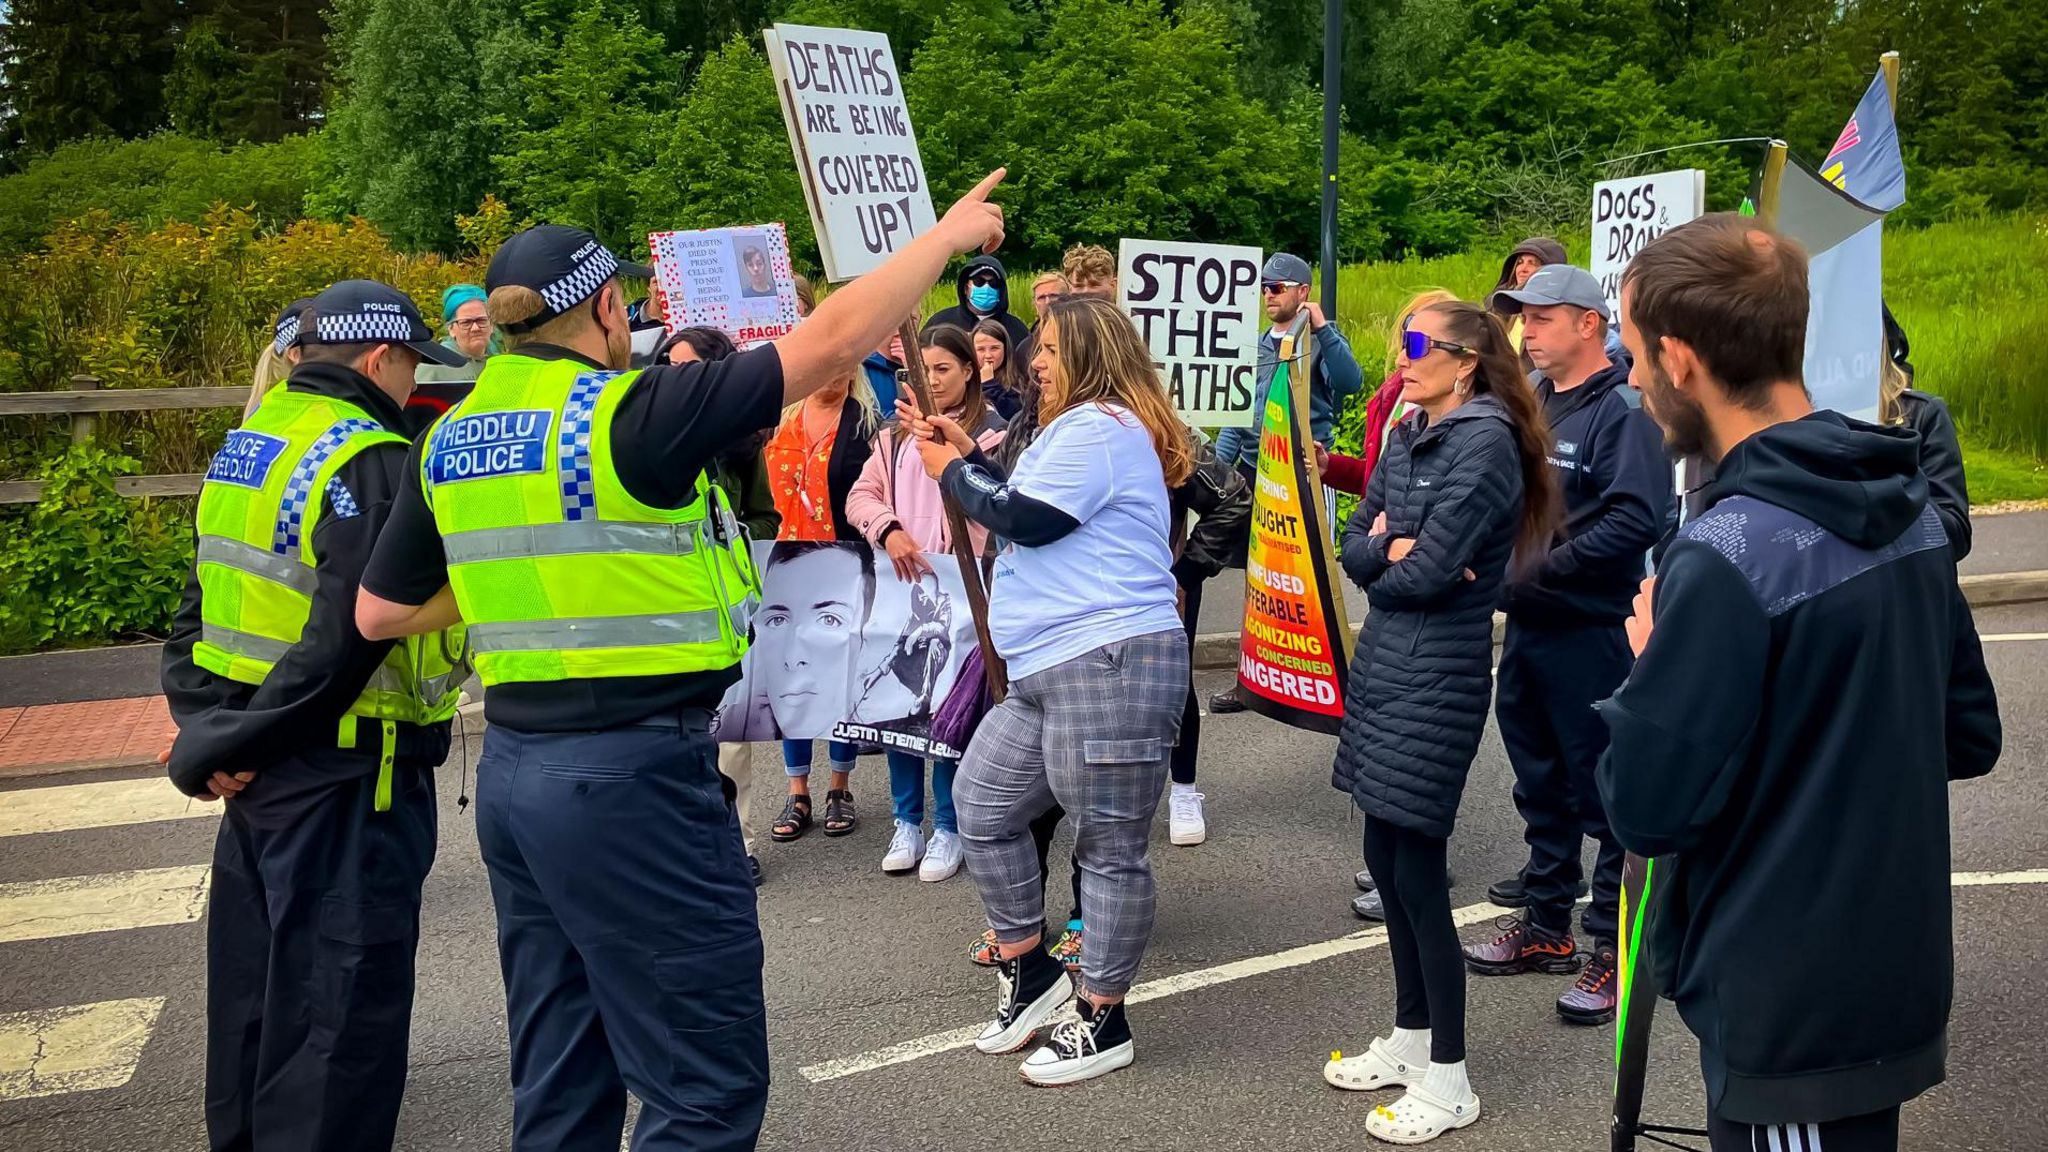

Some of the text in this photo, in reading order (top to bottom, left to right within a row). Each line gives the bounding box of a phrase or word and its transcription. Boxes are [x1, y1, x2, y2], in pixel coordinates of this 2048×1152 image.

[785, 40, 893, 96] DEATHS
[805, 104, 906, 137] ARE BEING
[818, 154, 918, 195] COVERED
[1596, 183, 1670, 226] DOGS &
[570, 240, 598, 263] POLICE
[678, 239, 723, 249] OUR JUSTIN
[688, 249, 707, 258] DIED
[687, 266, 724, 276] CELL DUE
[690, 257, 718, 267] PRISON
[694, 276, 721, 285] TO NOT
[697, 285, 722, 295] BEING
[1127, 253, 1257, 306] STOP
[363, 303, 401, 313] POLICE
[693, 294, 730, 305] CHECKED
[276, 315, 297, 332] POLICE
[739, 324, 793, 340] FRAGILE
[1130, 307, 1243, 359] THE
[1151, 362, 1253, 412] ATHS
[442, 414, 537, 449] HEDDLU
[443, 445, 525, 478] POLICE
[1254, 502, 1297, 539] AUGHT
[1245, 614, 1323, 655] AGONIZING
[1256, 645, 1333, 676] CONCERNED
[1240, 651, 1336, 706] ANGERED
